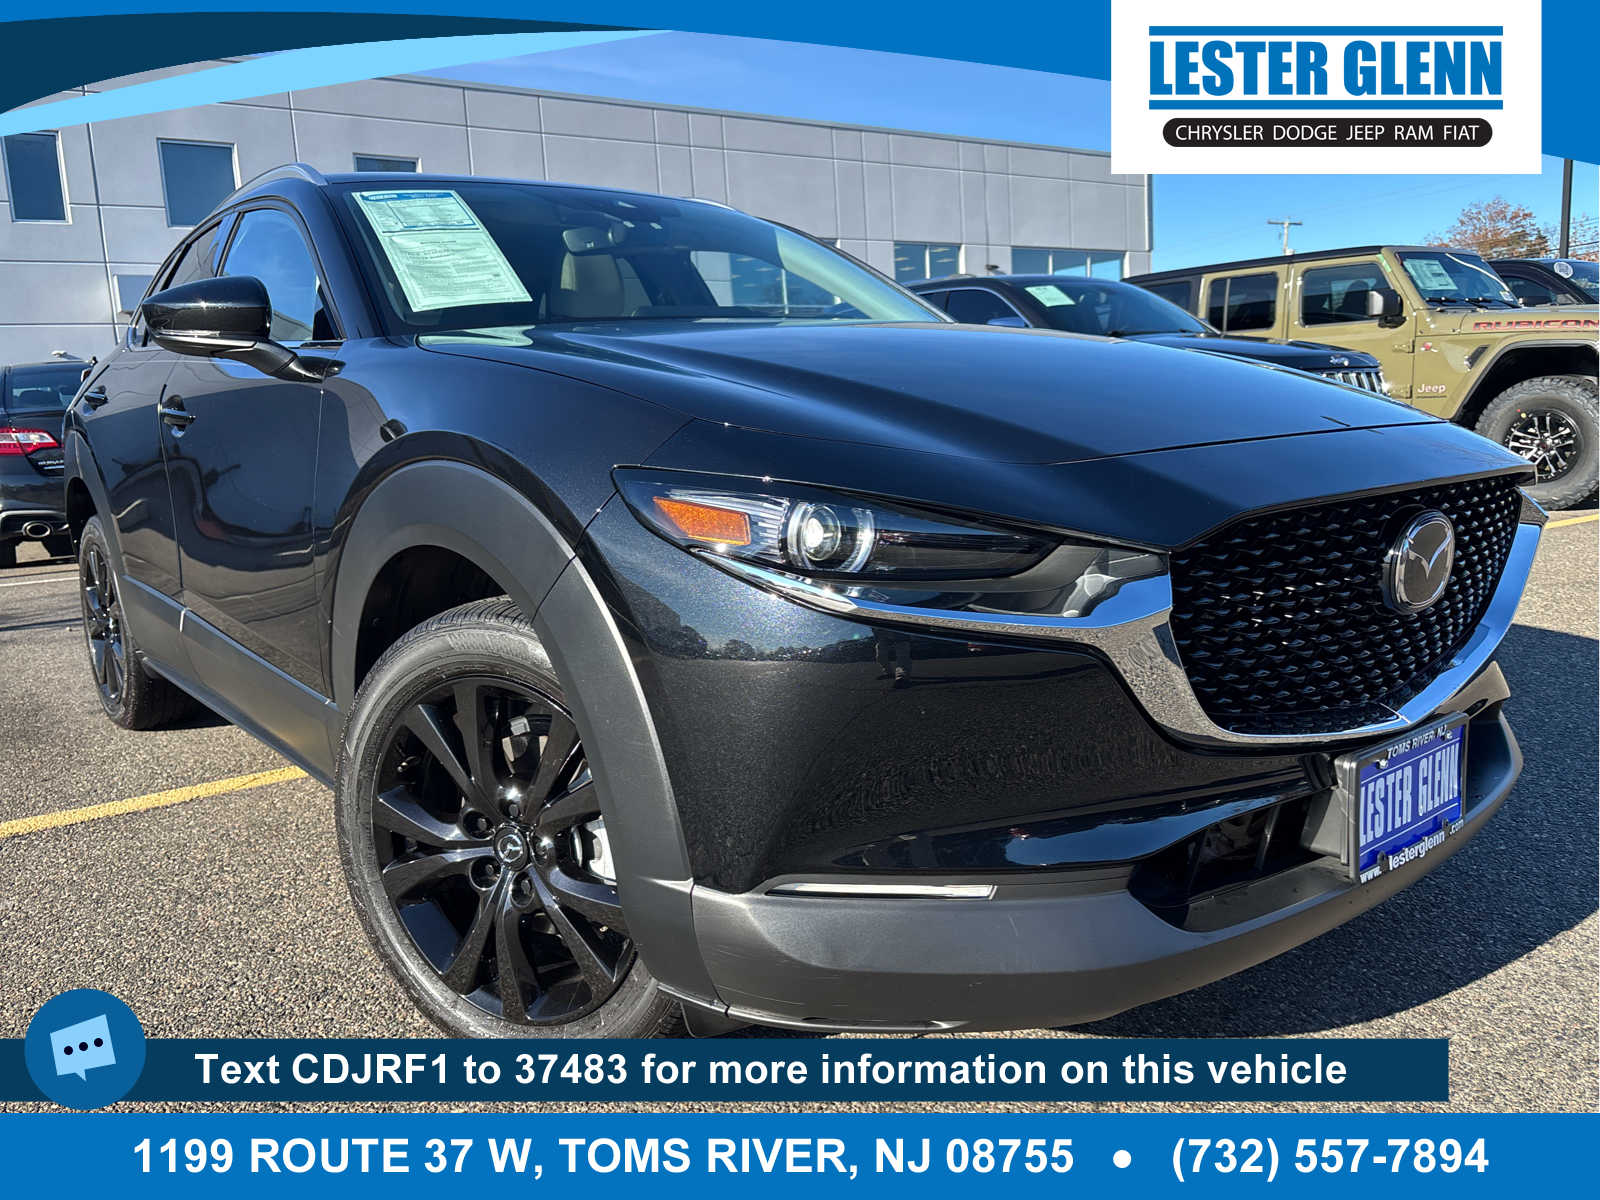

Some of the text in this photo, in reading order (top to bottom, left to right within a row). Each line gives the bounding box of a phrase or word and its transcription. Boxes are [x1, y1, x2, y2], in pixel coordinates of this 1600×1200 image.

[1472, 319, 1599, 331] RUBICON
[1417, 383, 1447, 394] Jeep
[1386, 740, 1412, 760] TOMS
[1436, 723, 1447, 738] NJ
[1360, 742, 1460, 848] LESTER GLENN
